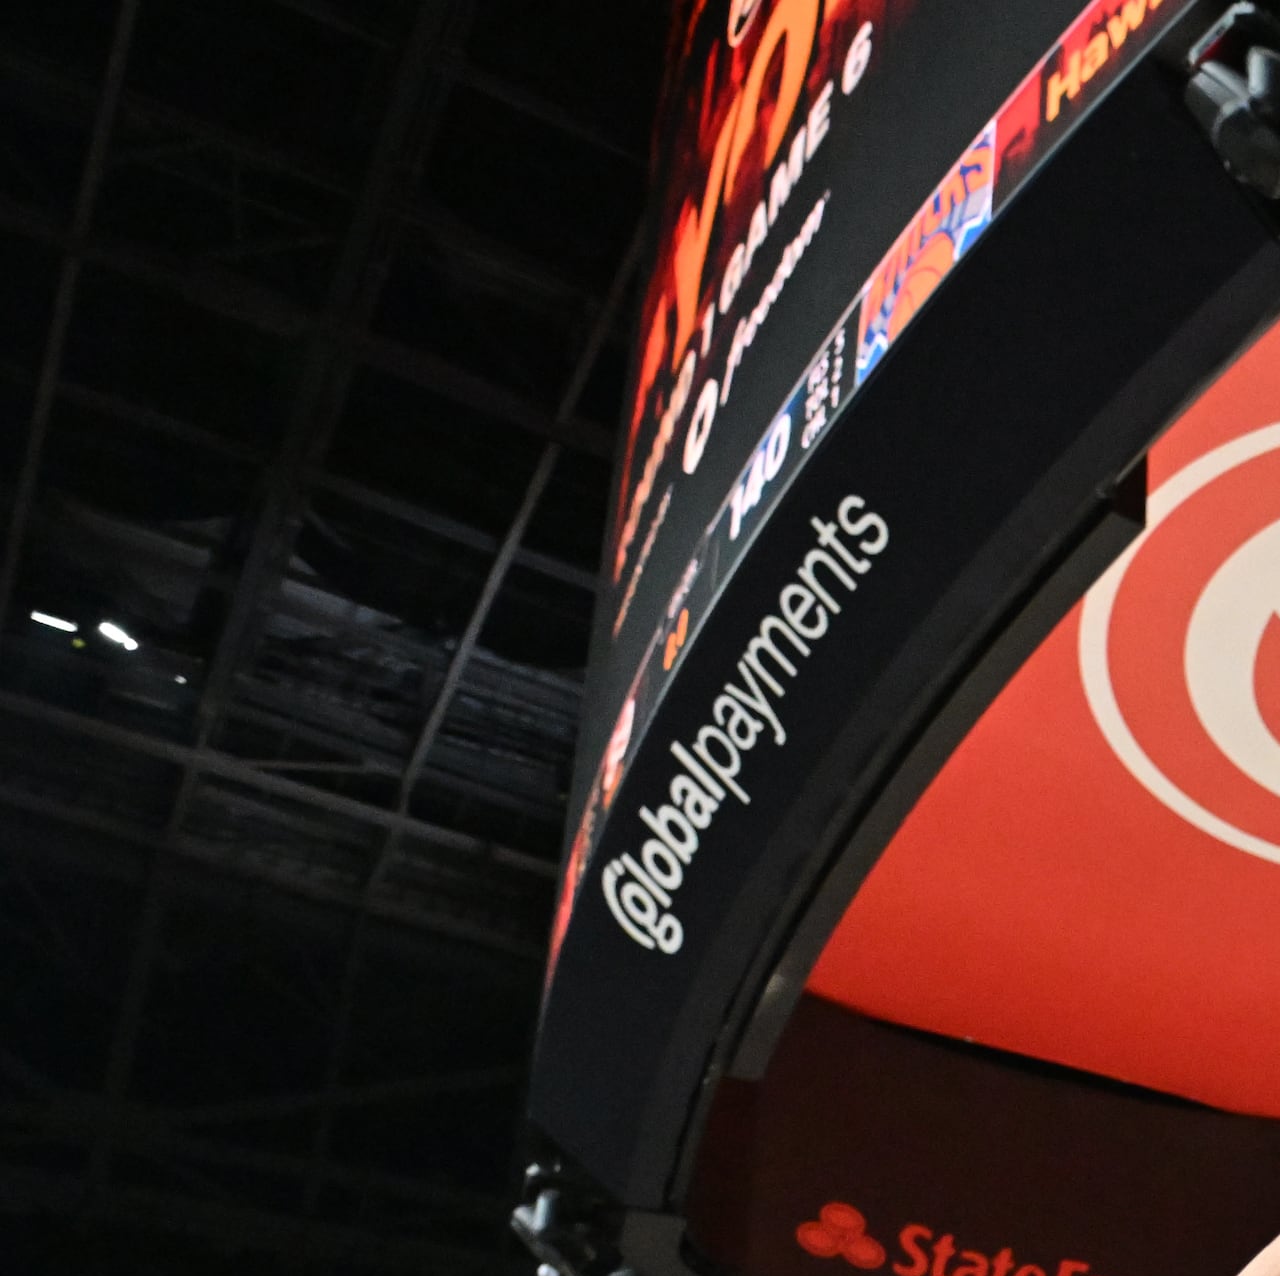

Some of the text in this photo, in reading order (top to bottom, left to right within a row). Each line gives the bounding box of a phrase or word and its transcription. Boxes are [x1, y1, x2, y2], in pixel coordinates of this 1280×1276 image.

[1046, 0, 1164, 122] Haw
[718, 79, 835, 315] GAME
[841, 20, 874, 95] 6
[728, 412, 791, 541] 140
